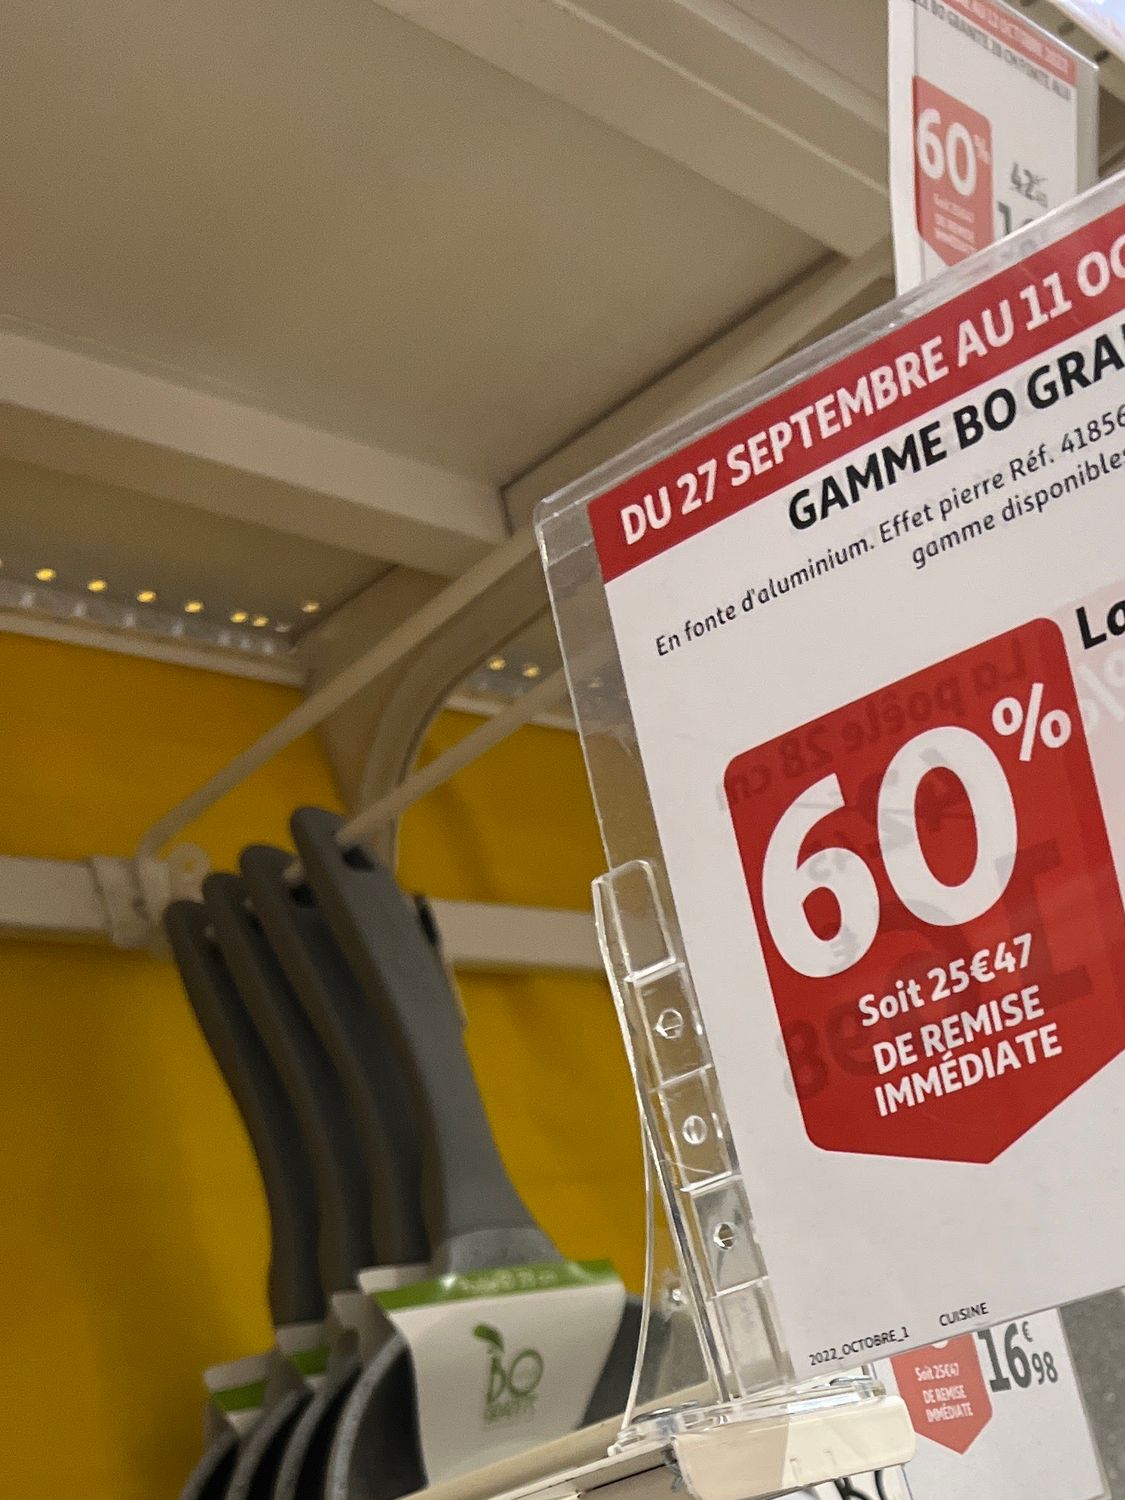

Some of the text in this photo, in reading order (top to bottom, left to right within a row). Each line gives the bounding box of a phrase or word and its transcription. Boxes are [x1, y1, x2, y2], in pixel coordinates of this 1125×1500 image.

[620, 504, 672, 545] DU
[677, 460, 719, 517] 27
[727, 335, 950, 492] SEPTEMBRE
[957, 309, 1016, 367] AU
[1023, 275, 1074, 332] 11
[788, 422, 948, 530] GAMME
[956, 387, 1017, 451] BO
[655, 631, 682, 657] En
[683, 603, 737, 648] fonte
[741, 534, 875, 618] d'aluminium.
[880, 504, 935, 545] Effet
[939, 473, 1005, 530] pierre
[1010, 446, 1055, 482] Réf.
[912, 515, 997, 570] gamme
[858, 932, 1034, 1027] Soit 25€47
[872, 984, 1045, 1076] DE REMISE
[874, 1023, 1064, 1117] IMMÉDIATE
[938, 1302, 989, 1326] CUISINE
[923, 1384, 967, 1404] DE REMISE
